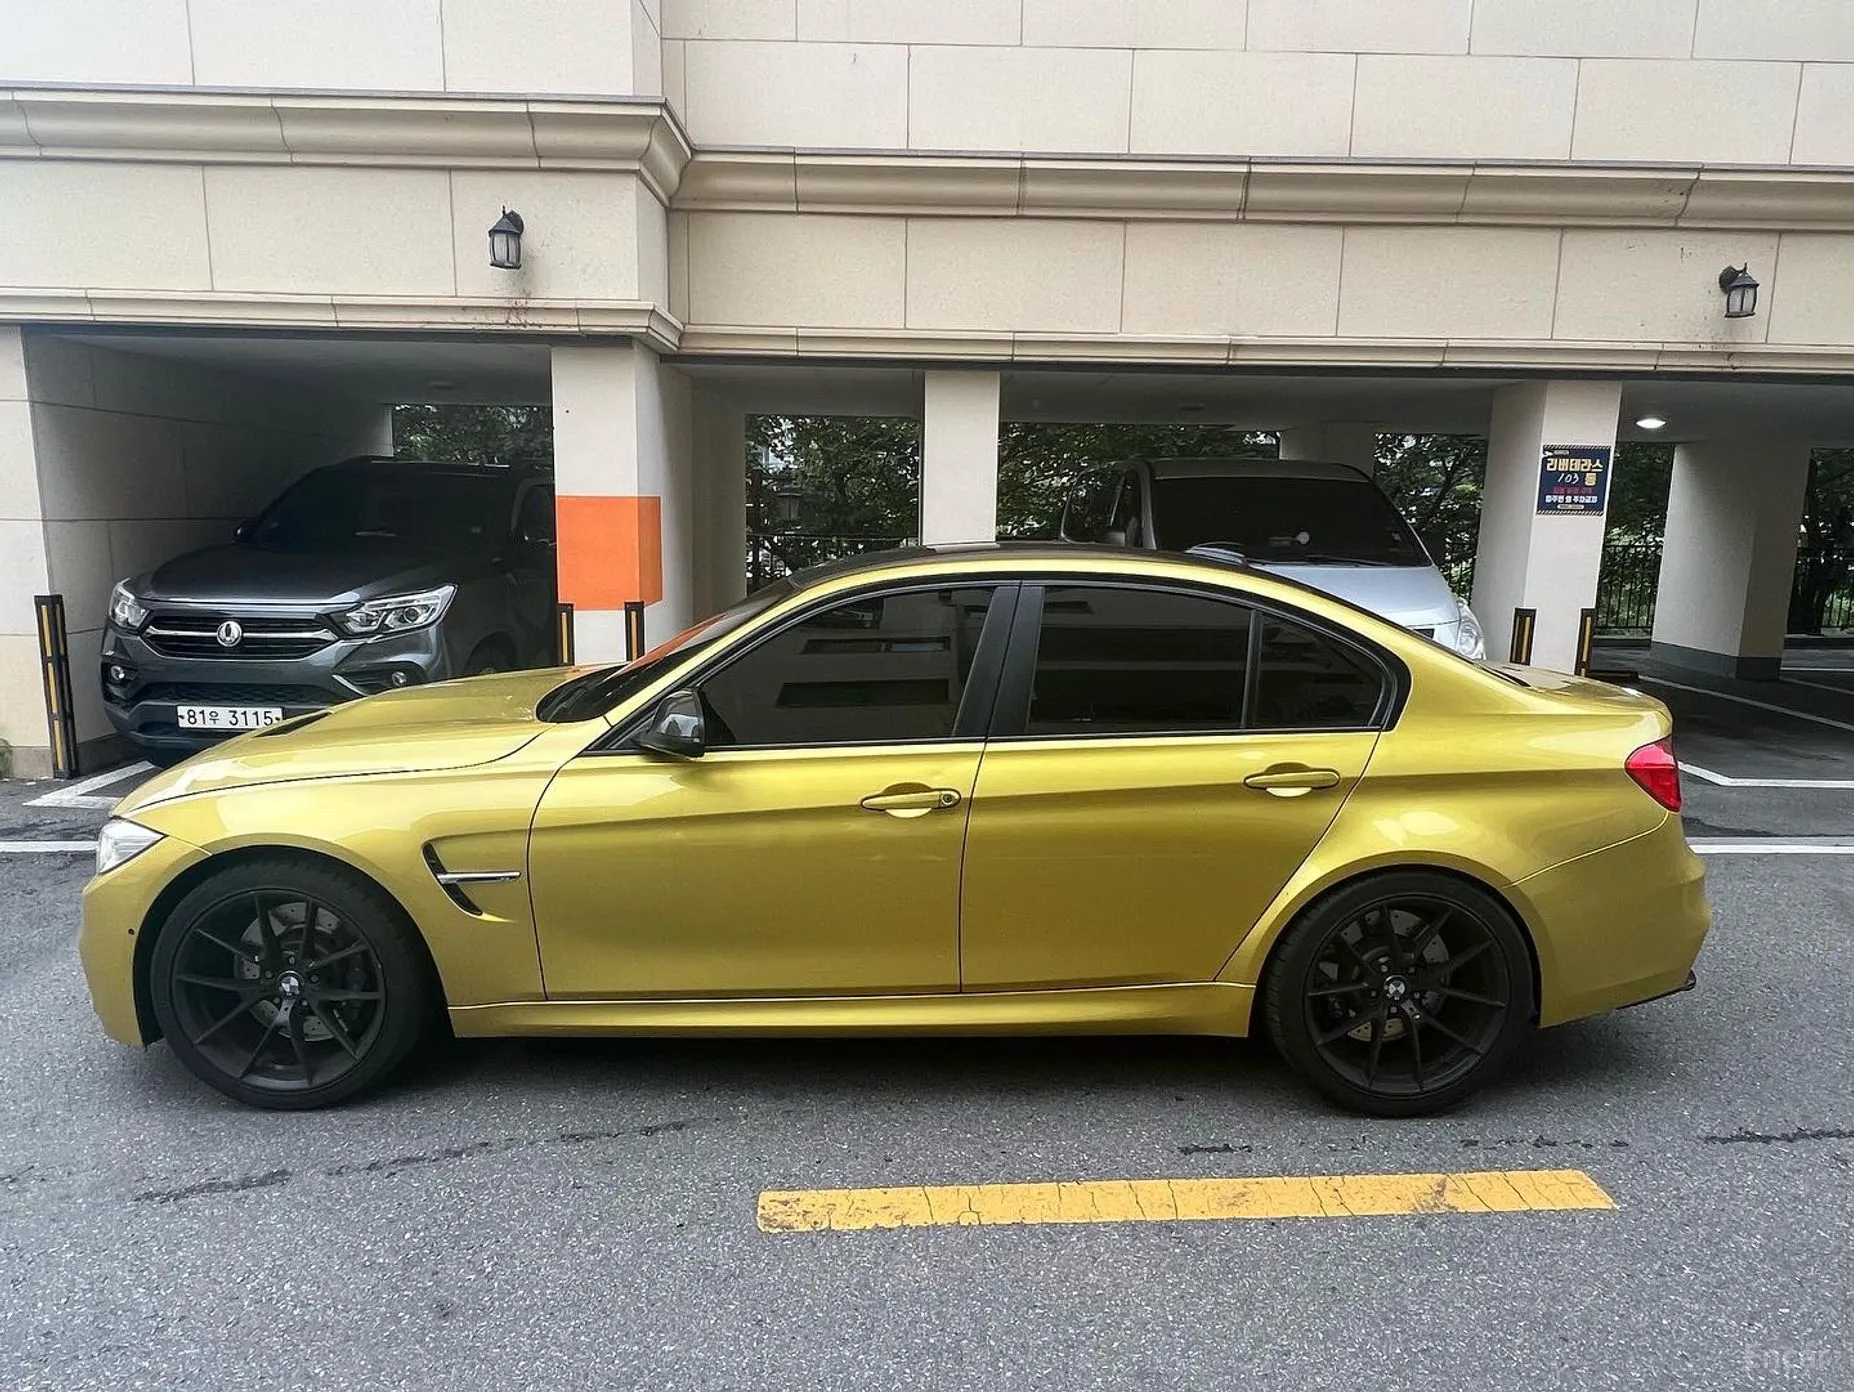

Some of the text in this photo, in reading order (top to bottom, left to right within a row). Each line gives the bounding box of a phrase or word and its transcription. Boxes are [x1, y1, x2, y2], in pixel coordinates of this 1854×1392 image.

[1546, 458, 1603, 472] 리버테라스
[1558, 473, 1579, 484] 103
[187, 709, 273, 726] 81우 3115
